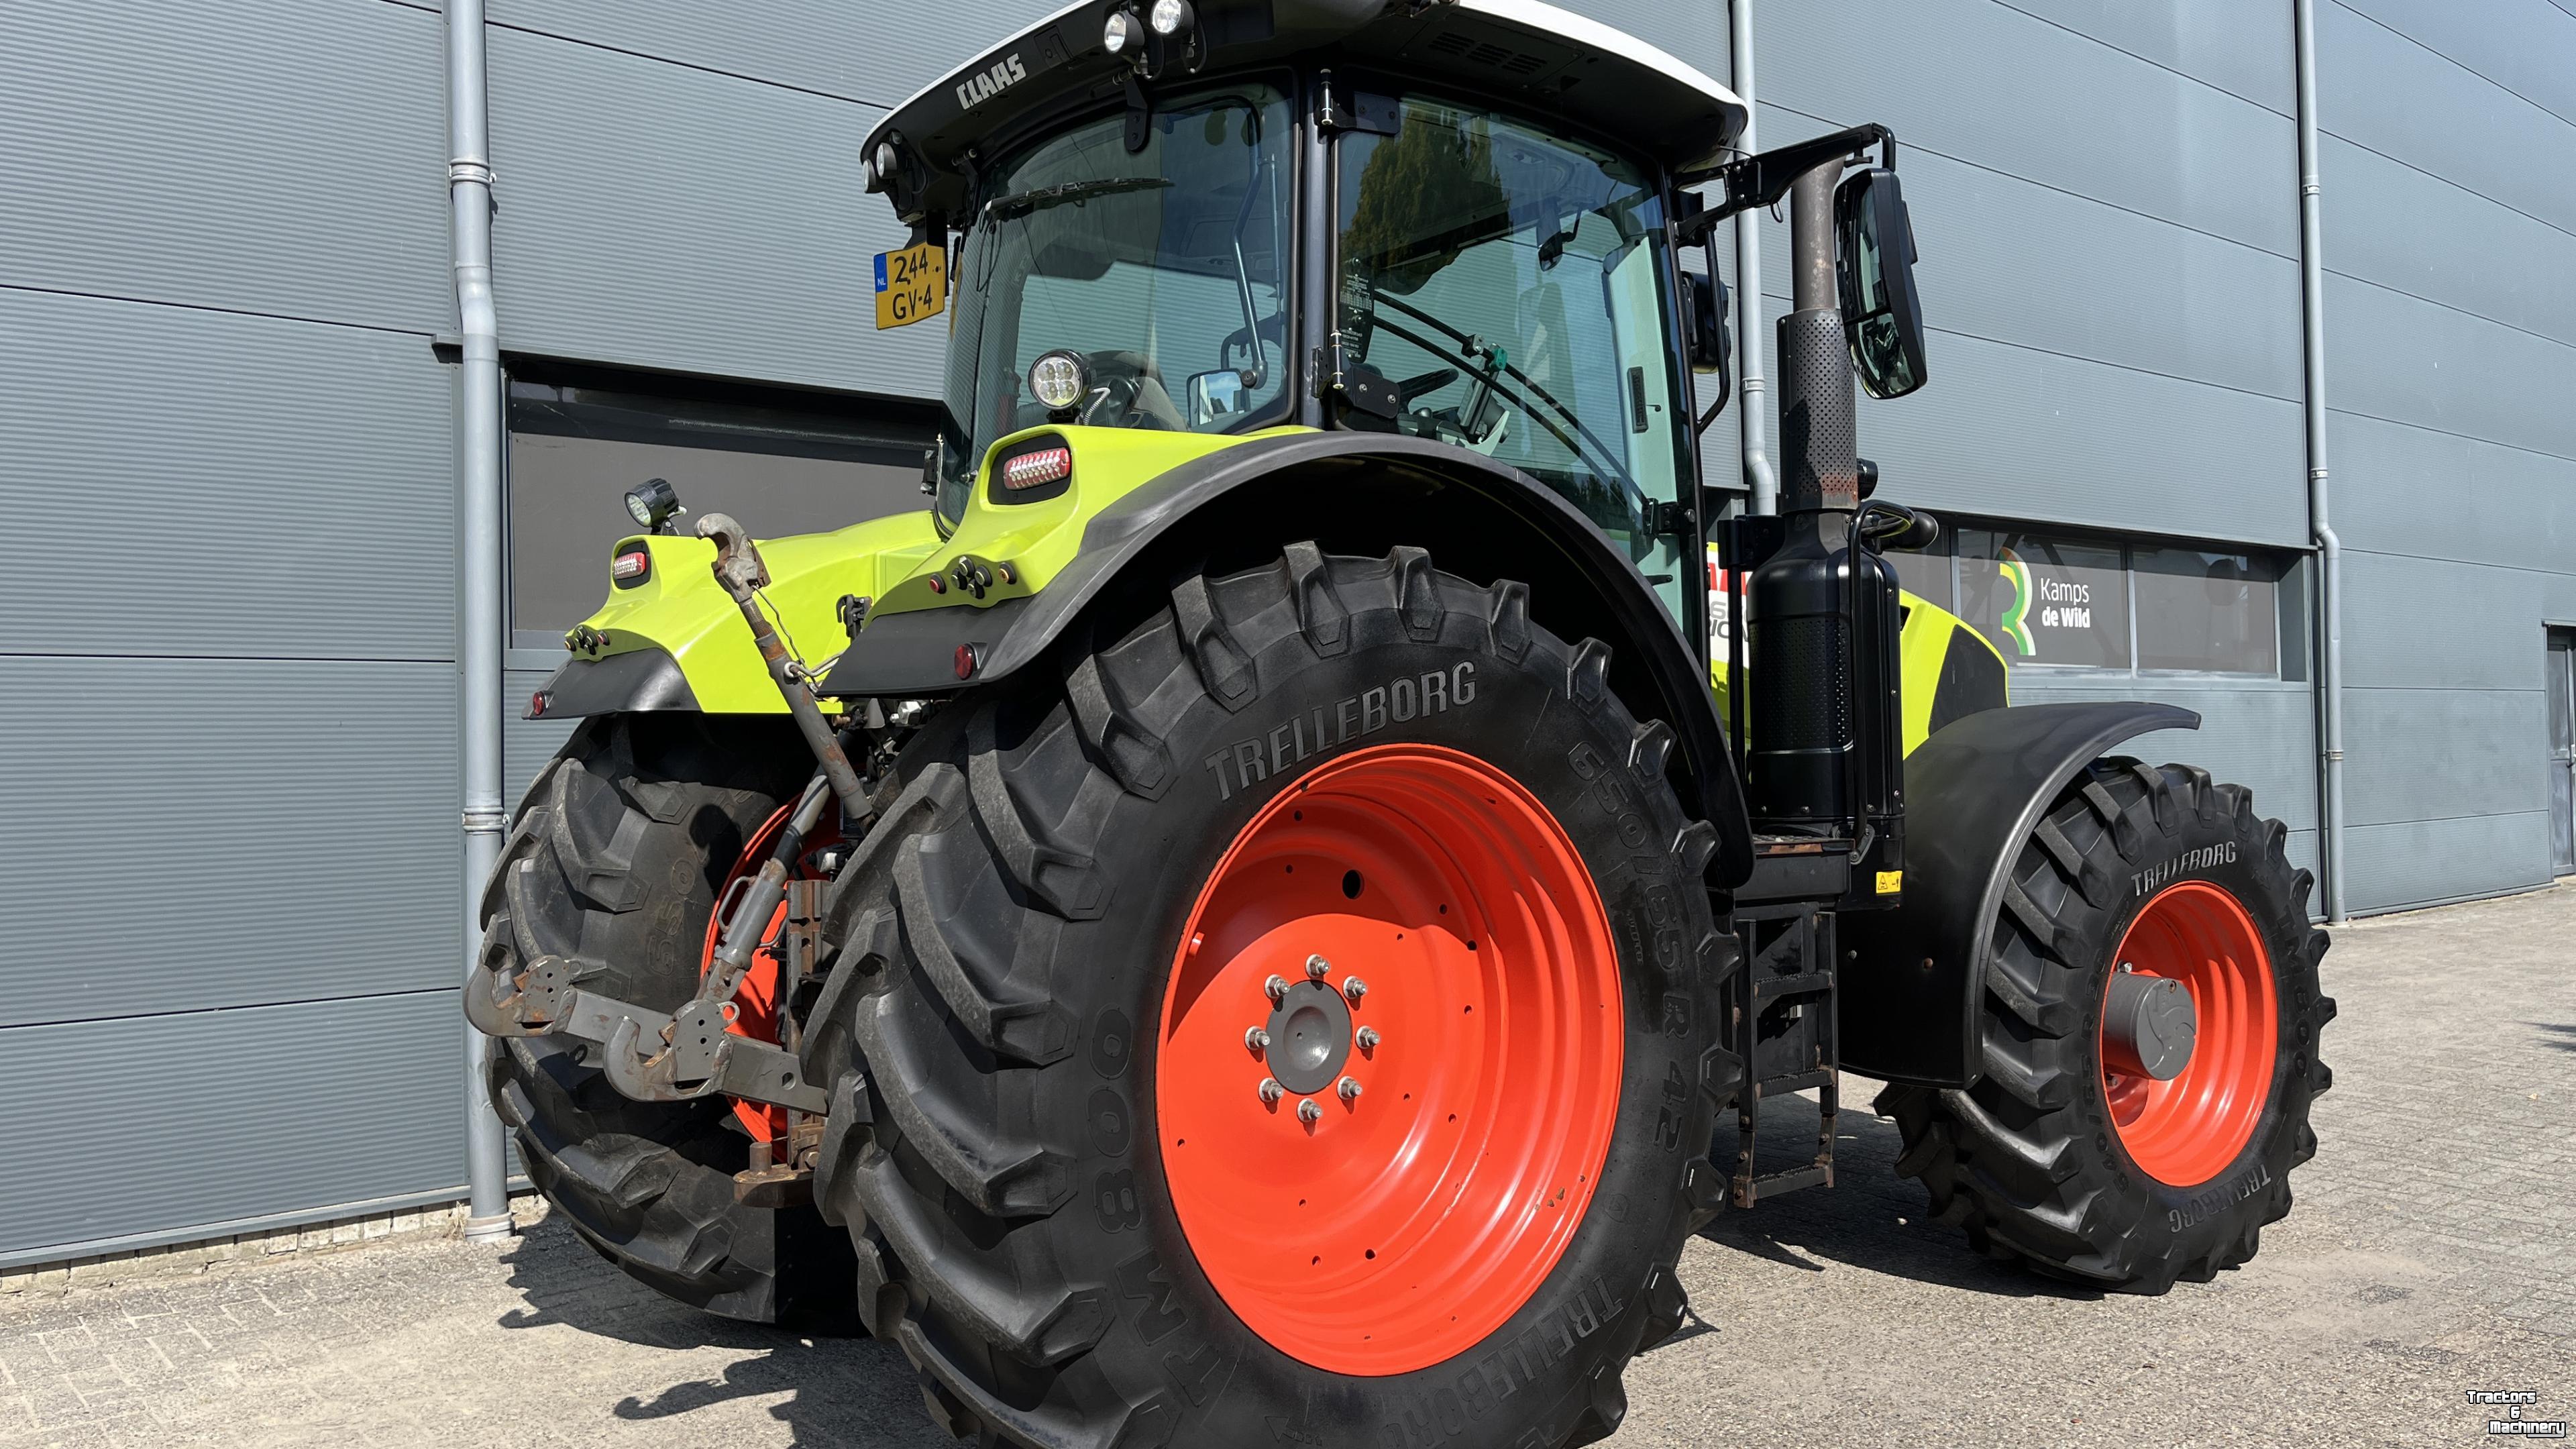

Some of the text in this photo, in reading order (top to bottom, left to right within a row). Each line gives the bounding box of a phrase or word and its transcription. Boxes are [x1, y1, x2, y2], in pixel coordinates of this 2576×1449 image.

[956, 53, 1026, 110] CLAAS
[877, 277, 886, 286] NL
[894, 247, 928, 284] 244
[892, 284, 932, 320] GV-4
[2041, 578, 2090, 605] Kamps
[2041, 606, 2091, 628] de Wild
[1202, 659, 1477, 802] TRELLEBORG
[2130, 840, 2237, 897] TRELLEBORG
[2167, 1164, 2271, 1234] TRELLEBORG
